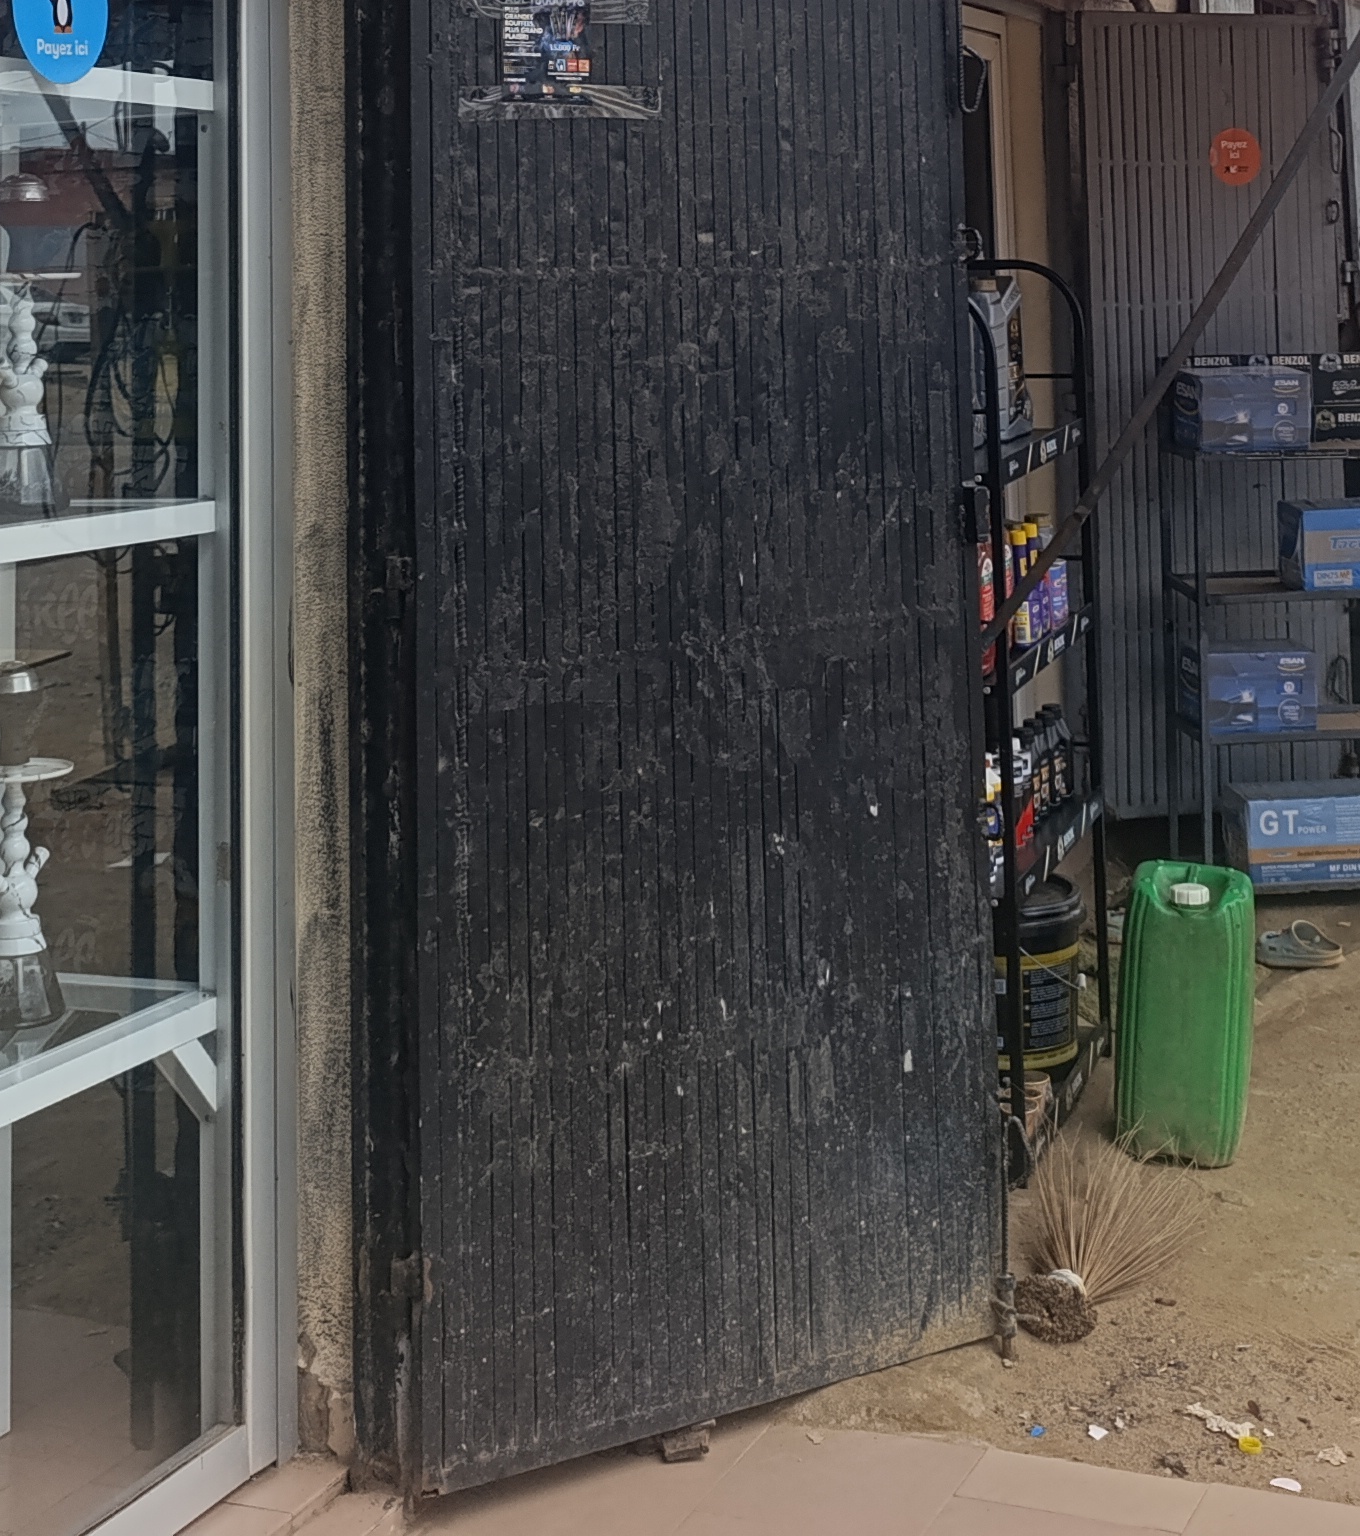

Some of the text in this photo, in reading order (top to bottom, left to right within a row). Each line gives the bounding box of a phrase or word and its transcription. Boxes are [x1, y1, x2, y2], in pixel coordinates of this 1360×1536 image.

[36, 38, 89, 60] Payez ici
[1220, 140, 1248, 151] Payez
[1194, 357, 1232, 366] BENZOL
[1272, 356, 1311, 365] BENZOL
[1274, 379, 1299, 387] ESAN
[1280, 657, 1305, 665] ESAN
[1298, 825, 1327, 834] POWER
